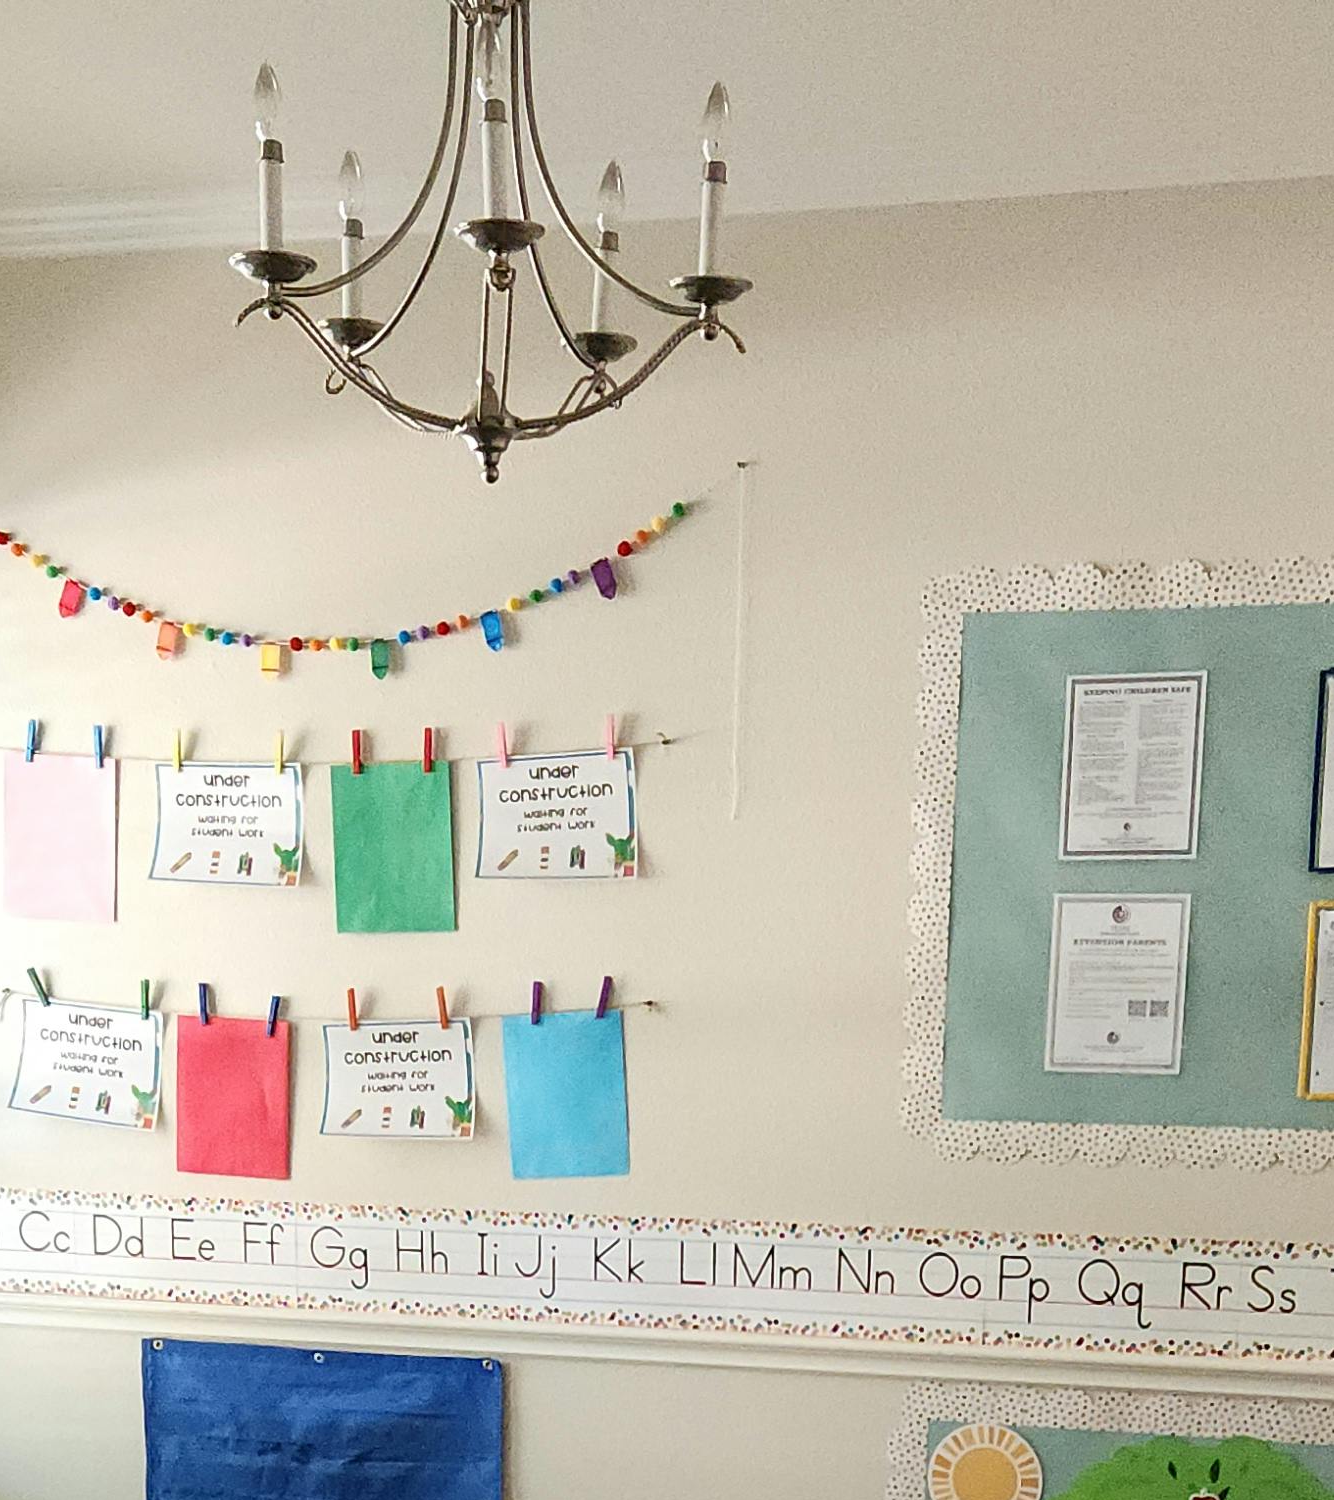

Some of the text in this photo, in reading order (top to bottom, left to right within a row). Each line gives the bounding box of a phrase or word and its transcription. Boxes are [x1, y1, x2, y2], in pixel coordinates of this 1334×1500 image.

[528, 764, 580, 780] under
[203, 773, 251, 788] under
[175, 792, 283, 808] construction
[498, 782, 614, 803] construction
[68, 1013, 114, 1029] under
[40, 1027, 143, 1052] construction
[371, 1031, 420, 1044] under
[343, 1049, 453, 1065] construction
[19, 1210, 71, 1253] Cc
[93, 1214, 144, 1258] Dd
[171, 1218, 216, 1262] Ee
[243, 1222, 284, 1265] Ff
[310, 1225, 368, 1290] Gg
[395, 1228, 449, 1275] Hh
[477, 1232, 499, 1276] Ii
[515, 1234, 557, 1299] Jj
[593, 1237, 645, 1283] Kk
[680, 1240, 716, 1287] Ll
[733, 1242, 812, 1291] Mm
[837, 1247, 895, 1295] Nn
[919, 1251, 982, 1299] Oo
[998, 1255, 1050, 1324] Pp
[1078, 1258, 1152, 1329] Qq
[1180, 1262, 1233, 1311] Rr
[1247, 1265, 1297, 1314] Ss
